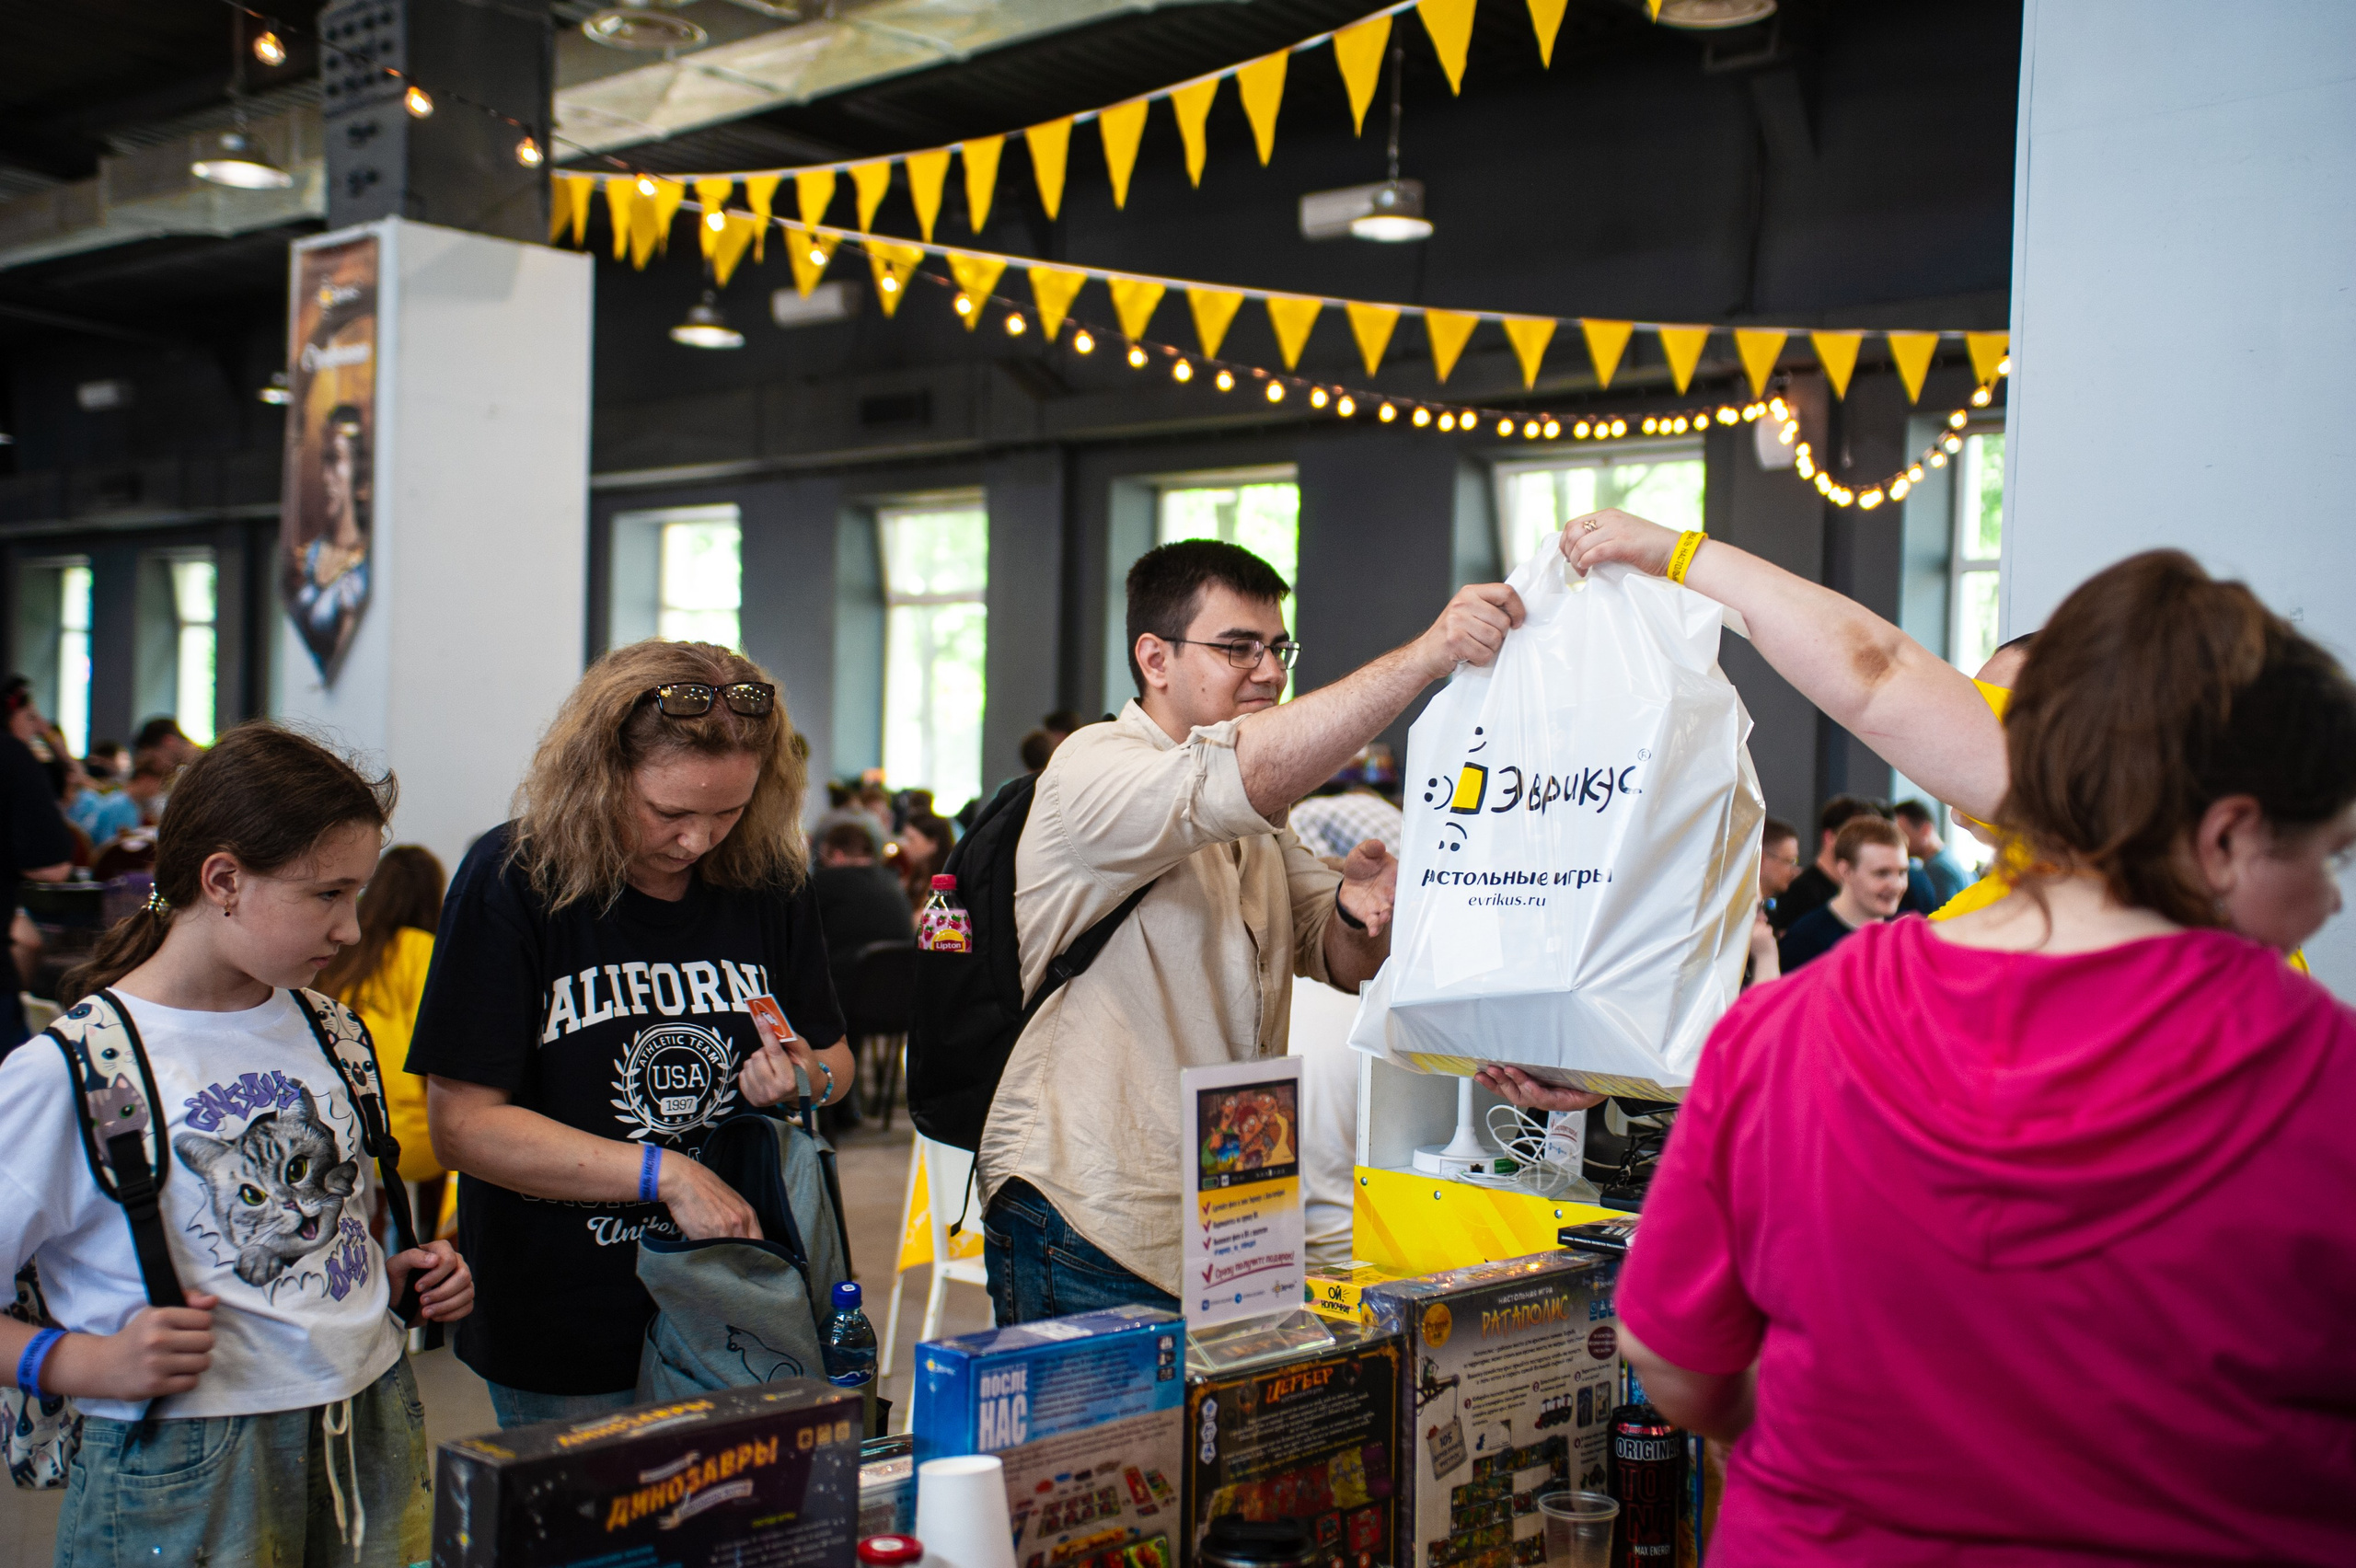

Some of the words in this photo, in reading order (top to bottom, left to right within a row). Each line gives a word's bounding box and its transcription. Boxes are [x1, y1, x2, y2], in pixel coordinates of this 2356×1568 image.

[1490, 766, 1642, 816] Эврикус
[1468, 893, 1547, 906] evrikus.ru
[935, 941, 963, 950] Lipton
[537, 959, 768, 1049] ALIFORN
[639, 1035, 686, 1067] ATHLETIC
[689, 1036, 720, 1065] TEAM
[653, 1063, 707, 1090] USA
[184, 1069, 302, 1132] ENJOY
[665, 1098, 694, 1112] 1997
[325, 1243, 369, 1302] DAY
[1498, 1290, 1538, 1305] НАСТОЛЬНАЯ
[1538, 1286, 1553, 1297] ИГРА
[1482, 1294, 1569, 1340] РАТАПОЛИС
[978, 1393, 1028, 1452] НАС
[1615, 1436, 1680, 1461] ORIGINA
[606, 1435, 780, 1534] ДИНОЗАВРЫ
[1634, 1545, 1649, 1556] MAX
[1649, 1544, 1670, 1556] ENERGY
